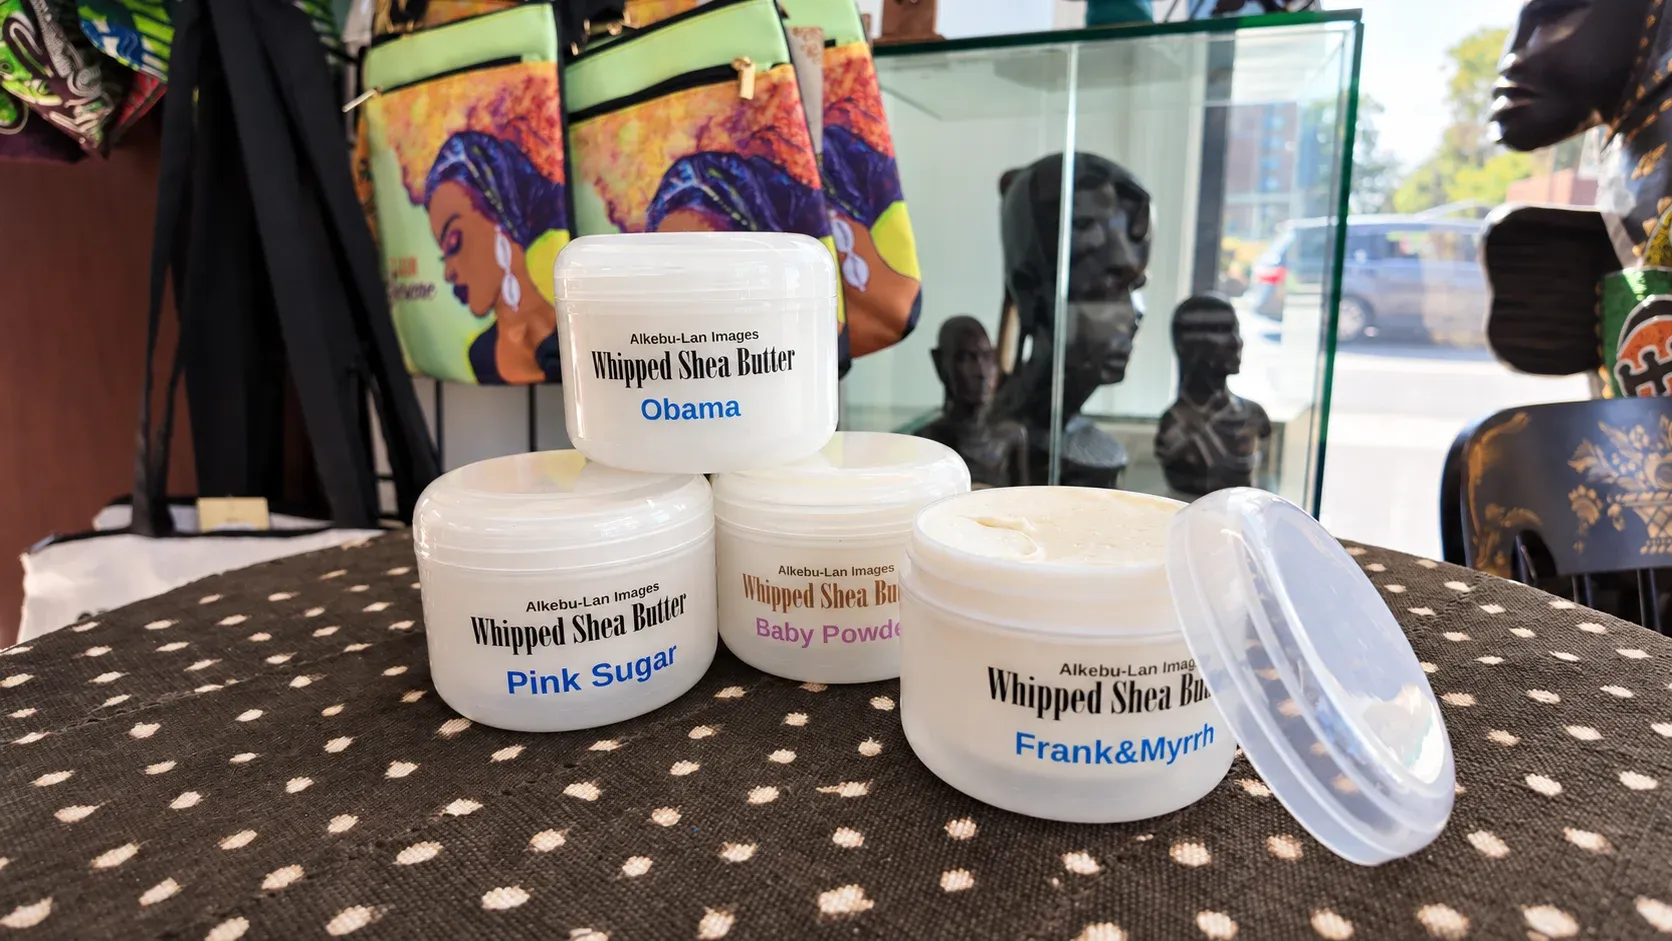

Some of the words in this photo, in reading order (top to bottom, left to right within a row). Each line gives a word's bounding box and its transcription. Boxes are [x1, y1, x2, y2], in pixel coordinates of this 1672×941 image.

[630, 332, 707, 345] Alkebu-Lan
[711, 330, 760, 343] Images
[591, 350, 672, 389] Whipped
[678, 350, 732, 380] Shea
[736, 347, 796, 378] Butter
[641, 397, 742, 421] Obama
[778, 565, 848, 577] Alkebu-Lan
[851, 564, 895, 577] Images
[525, 593, 610, 613] Alkebu-Lan
[614, 582, 660, 602] Images
[743, 573, 815, 614] Whipped
[820, 582, 869, 609] Shea
[874, 579, 900, 607] Bu
[470, 616, 566, 655] Whipped
[571, 612, 628, 644] Shea
[632, 592, 688, 633] Butter
[756, 616, 815, 649] Baby
[506, 667, 582, 695] Pink
[591, 645, 678, 687] Sugar
[1059, 663, 1158, 678] Alkebu-Lan
[1162, 658, 1196, 674] Imag
[987, 666, 1102, 721] Whipped
[1110, 681, 1172, 714] Shea
[1015, 722, 1215, 766] Frank&Myrrh
